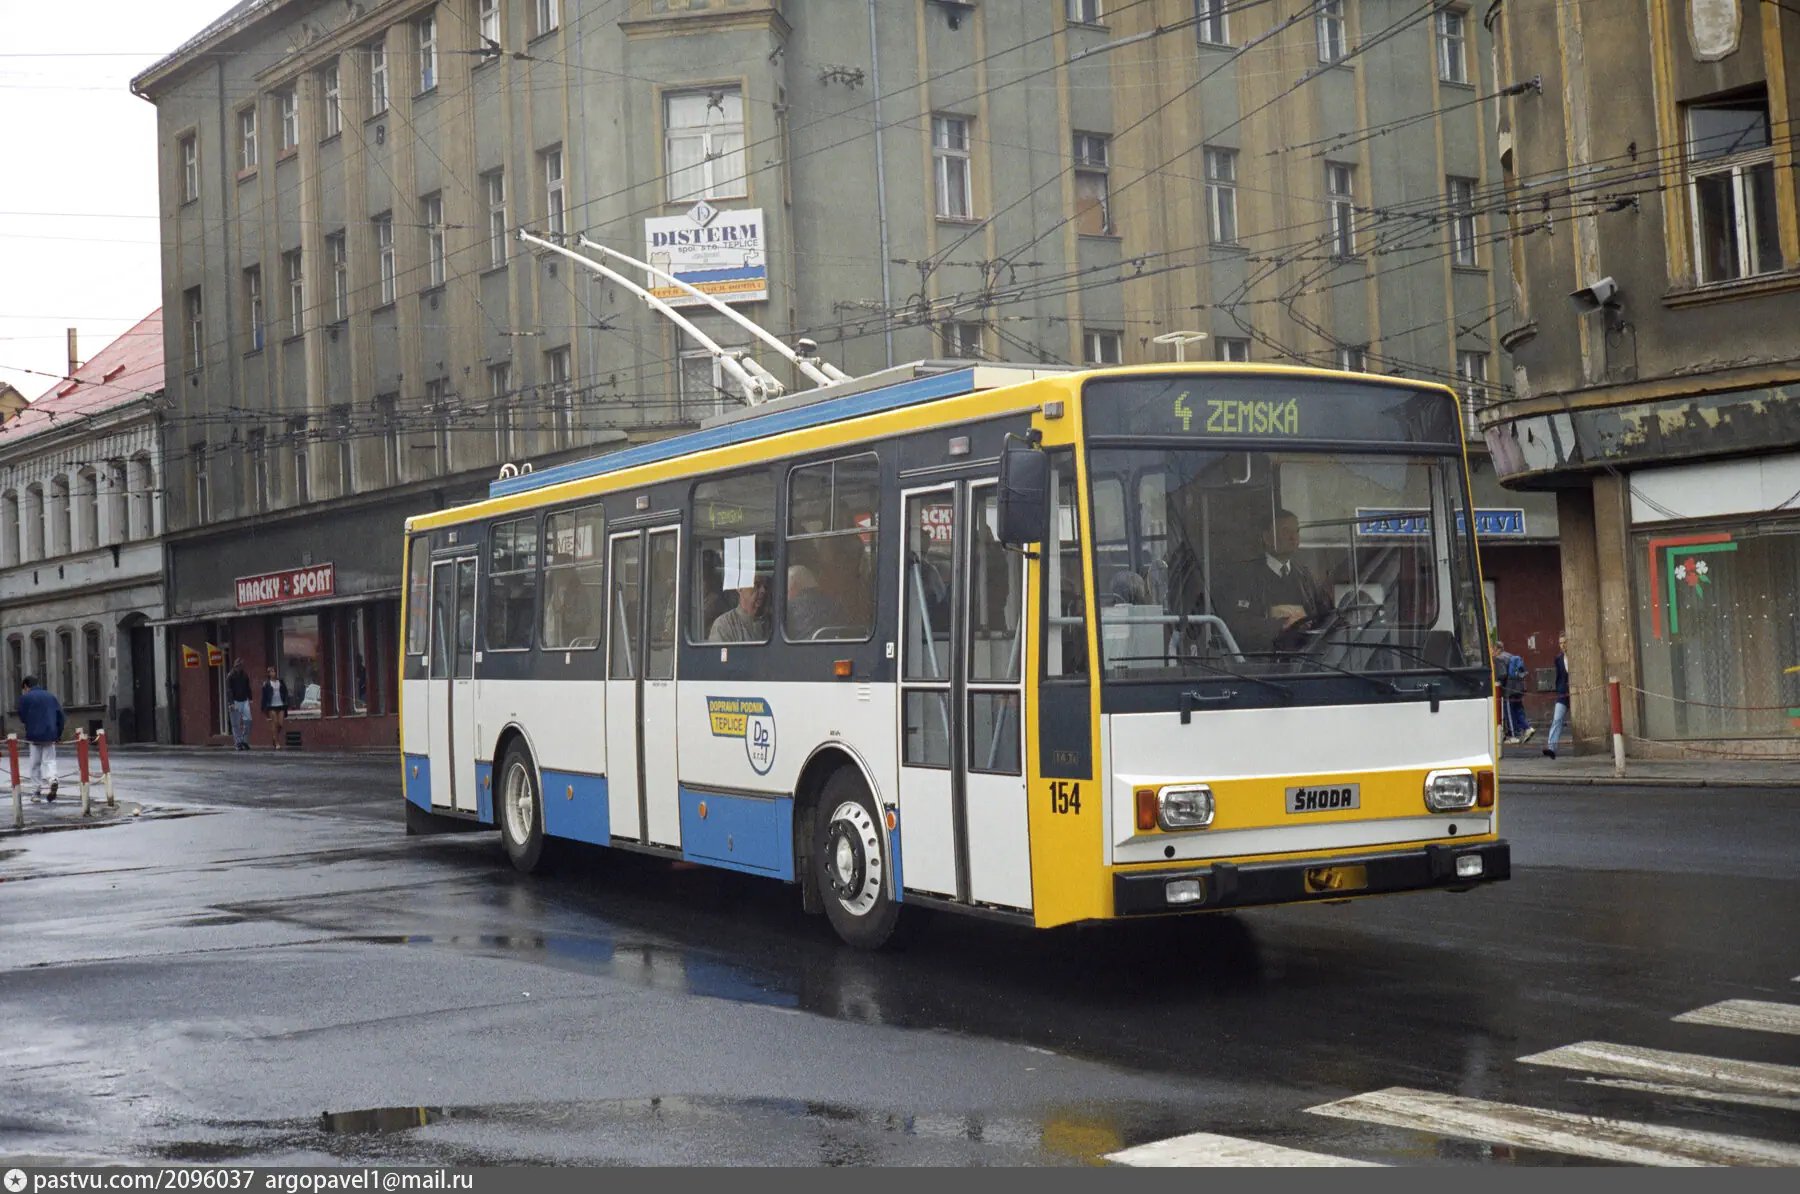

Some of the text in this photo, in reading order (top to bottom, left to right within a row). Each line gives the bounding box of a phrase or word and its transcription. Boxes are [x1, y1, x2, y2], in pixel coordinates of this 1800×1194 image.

[652, 223, 757, 247] DISTERM
[723, 238, 759, 249] TEPLICE
[1173, 391, 1299, 434] 4 ZEMSKÁ
[238, 568, 331, 604] HRAČKY SPORT
[740, 701, 764, 713] PODNIK
[715, 716, 743, 731] TEPLICE
[1049, 782, 1081, 815] 154
[1294, 786, 1352, 811] ŠKODA
